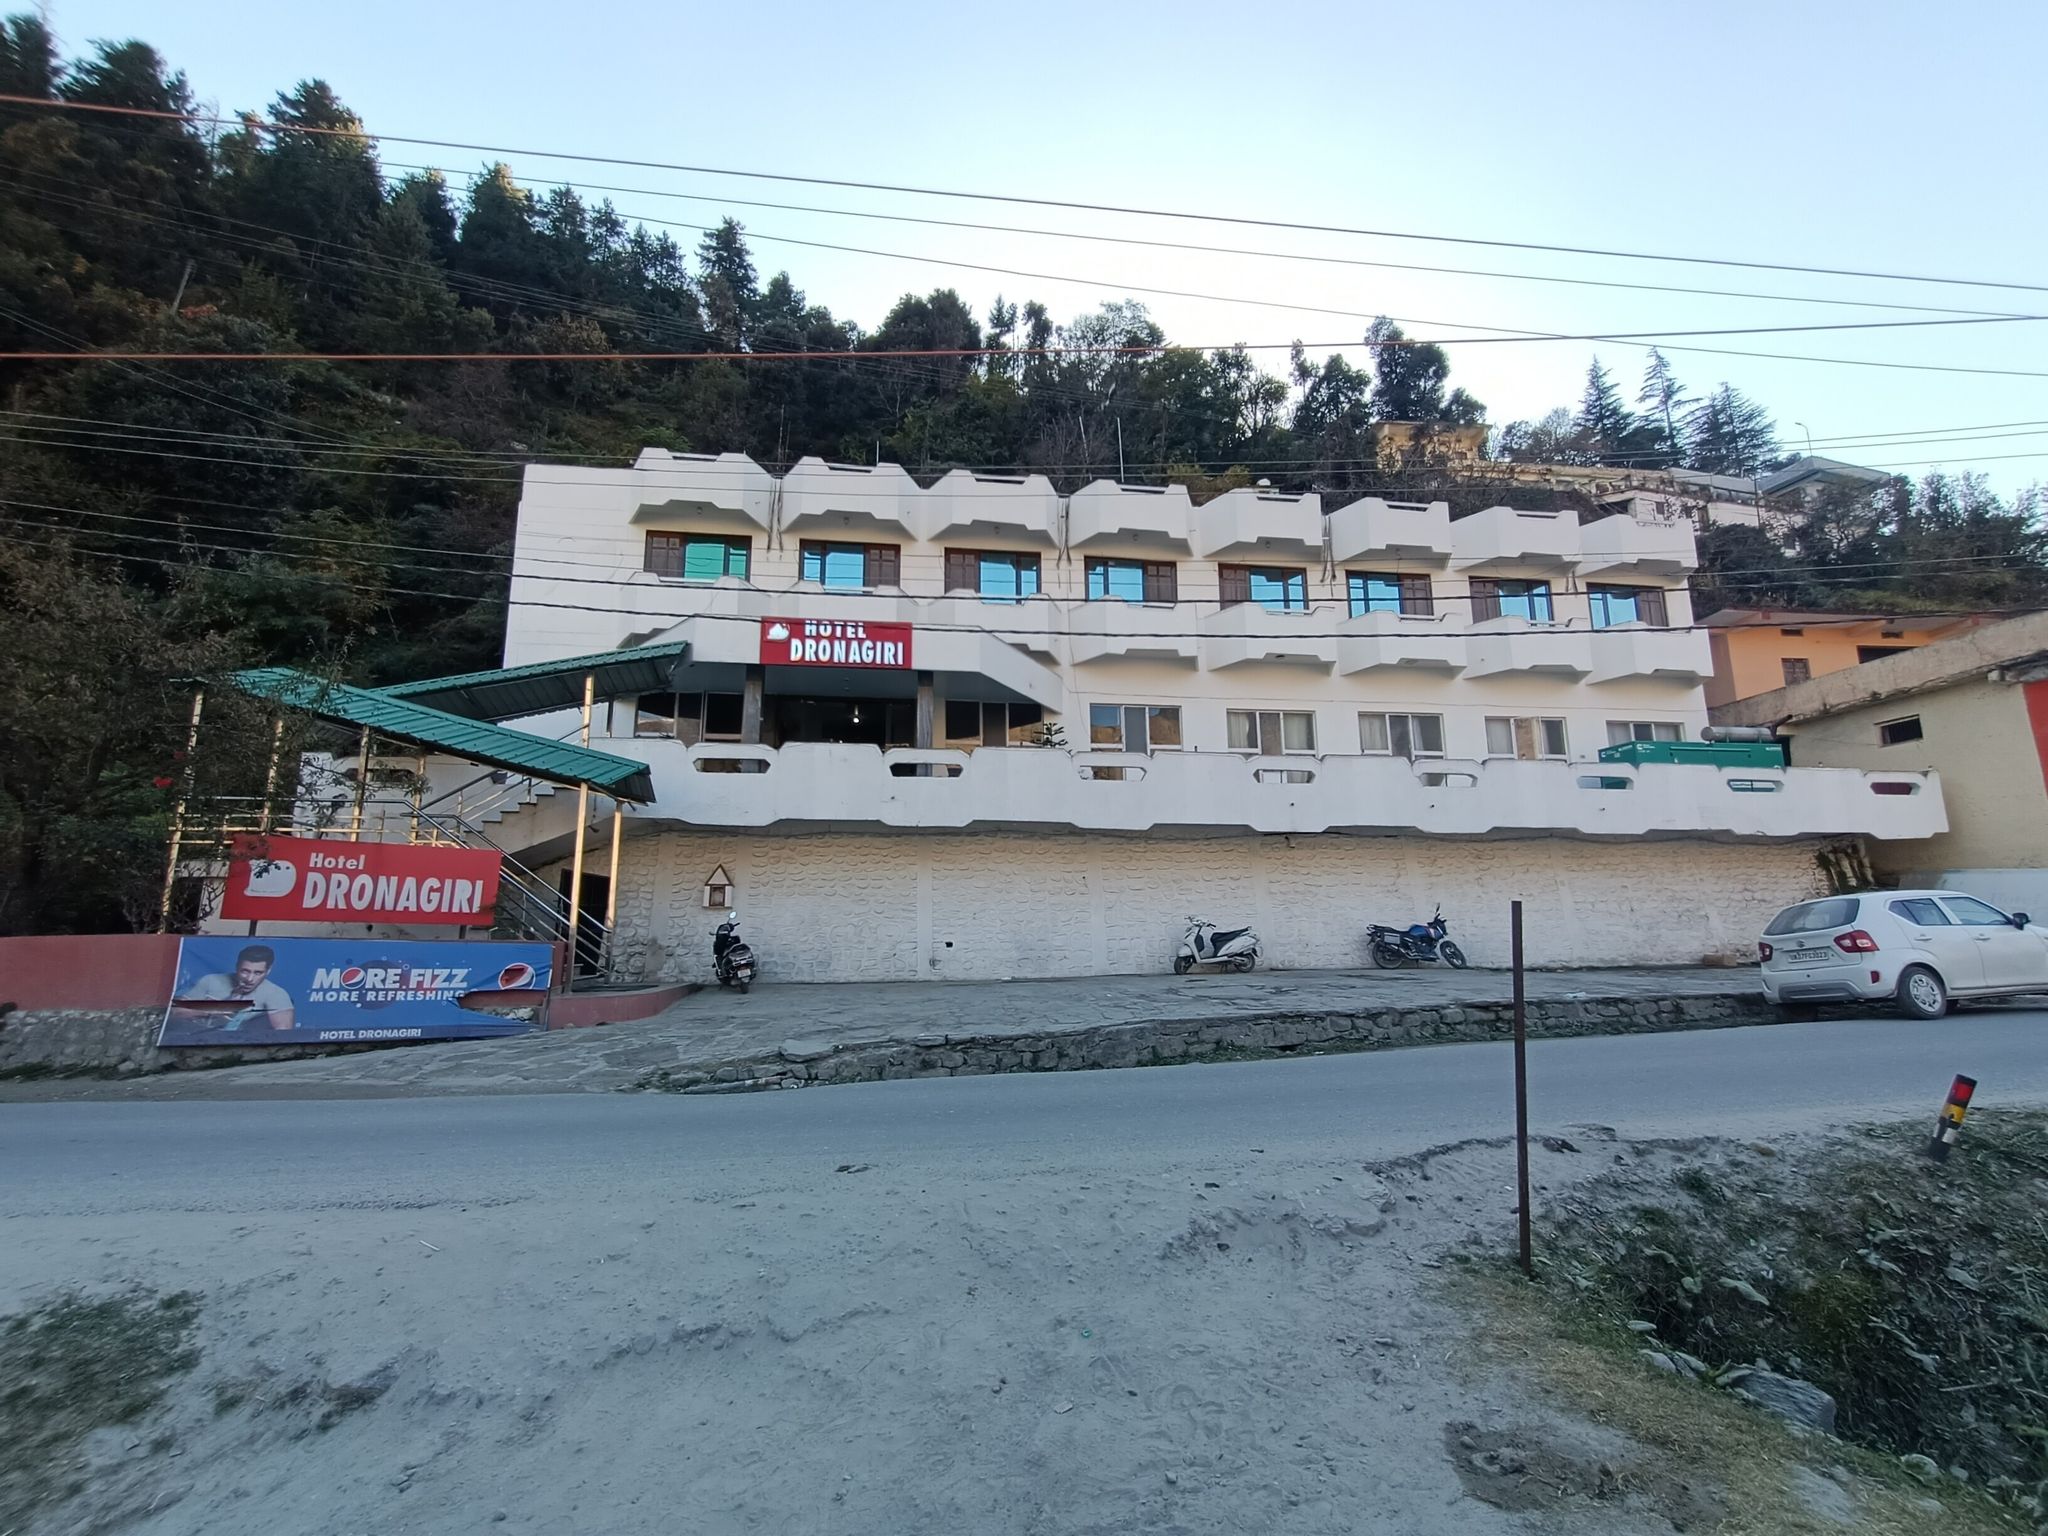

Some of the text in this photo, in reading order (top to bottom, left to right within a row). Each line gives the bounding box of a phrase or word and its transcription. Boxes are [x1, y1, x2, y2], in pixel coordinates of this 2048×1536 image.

[804, 620, 867, 638] HOTEL
[790, 639, 903, 665] DRONAGIRI
[309, 853, 366, 870] Hotel
[303, 872, 484, 913] DRONAGIRI
[409, 968, 470, 988] FIZZ
[310, 990, 466, 1001] MORE REFRESHING
[321, 1029, 422, 1040] HOTEL DRONAGIRI
